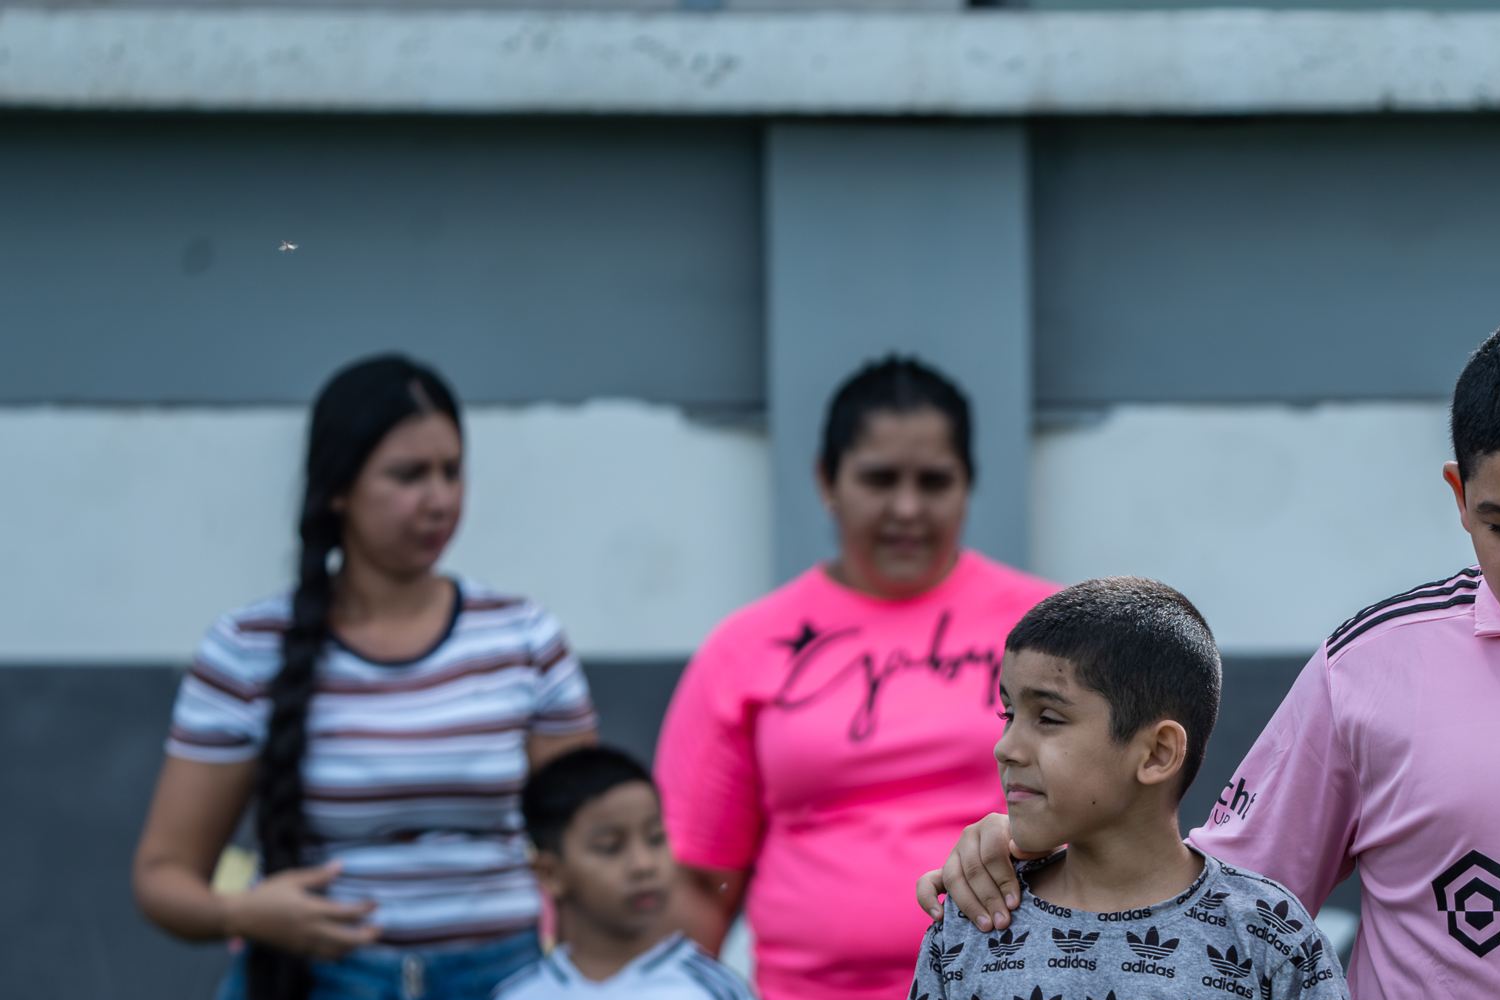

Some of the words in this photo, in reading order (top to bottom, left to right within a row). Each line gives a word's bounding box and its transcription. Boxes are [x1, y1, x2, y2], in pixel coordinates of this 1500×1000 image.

[1217, 777, 1257, 820] cht
[1097, 906, 1152, 922] adidas
[1184, 906, 1227, 927] didas
[1246, 924, 1293, 956] adidas
[981, 957, 1025, 973] adidas
[1048, 955, 1097, 971] adidas
[1121, 960, 1175, 978] adidas
[1202, 976, 1253, 999] adidas
